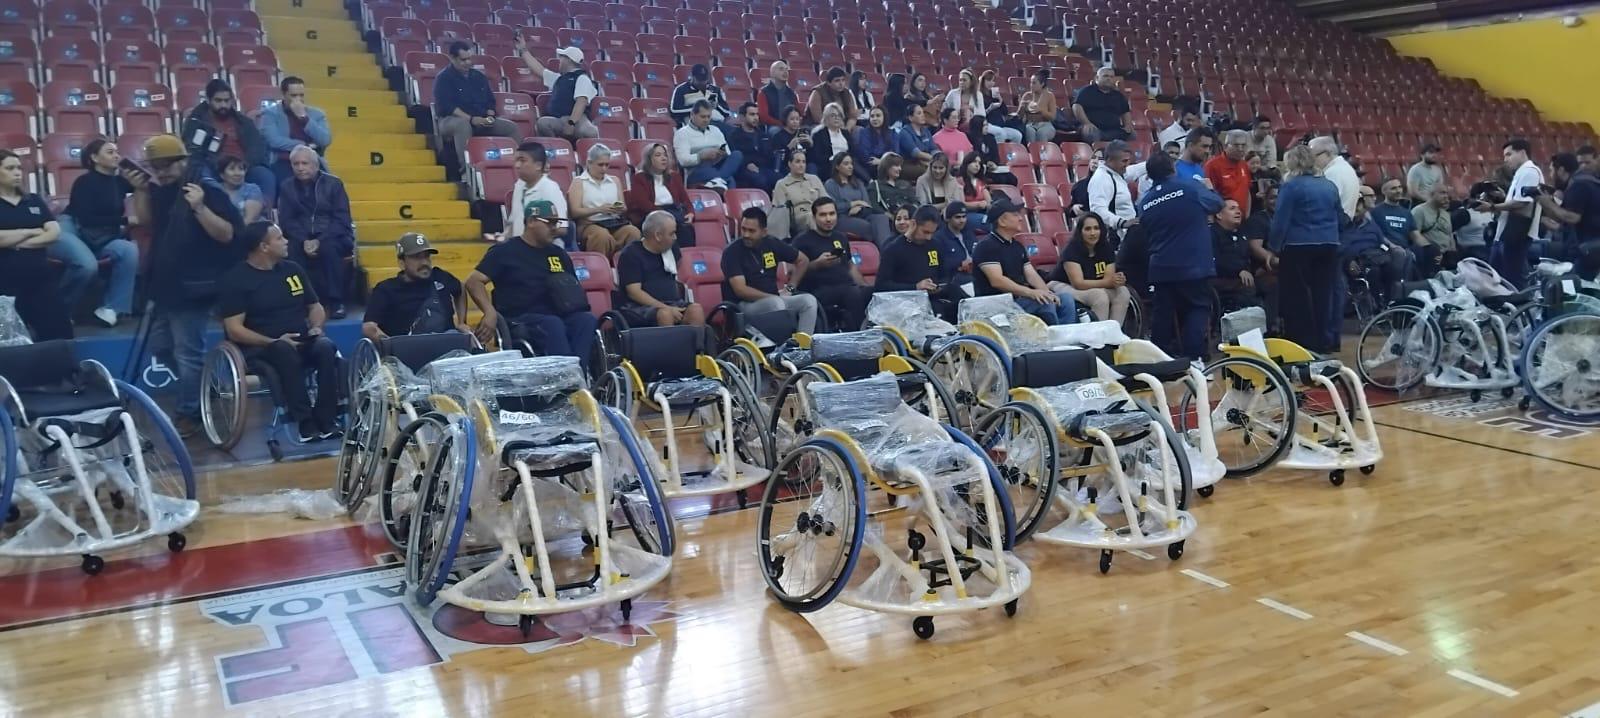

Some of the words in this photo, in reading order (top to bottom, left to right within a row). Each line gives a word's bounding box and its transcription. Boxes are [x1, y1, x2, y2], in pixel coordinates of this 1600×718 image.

[306, 30, 317, 40] G
[327, 66, 336, 77] F
[347, 106, 358, 118] E
[370, 152, 384, 165] D
[1143, 189, 1184, 211] BRONCOS
[399, 204, 413, 219] C
[1095, 261, 1106, 275] 10
[286, 274, 303, 291] 11
[208, 580, 408, 627] ALOA
